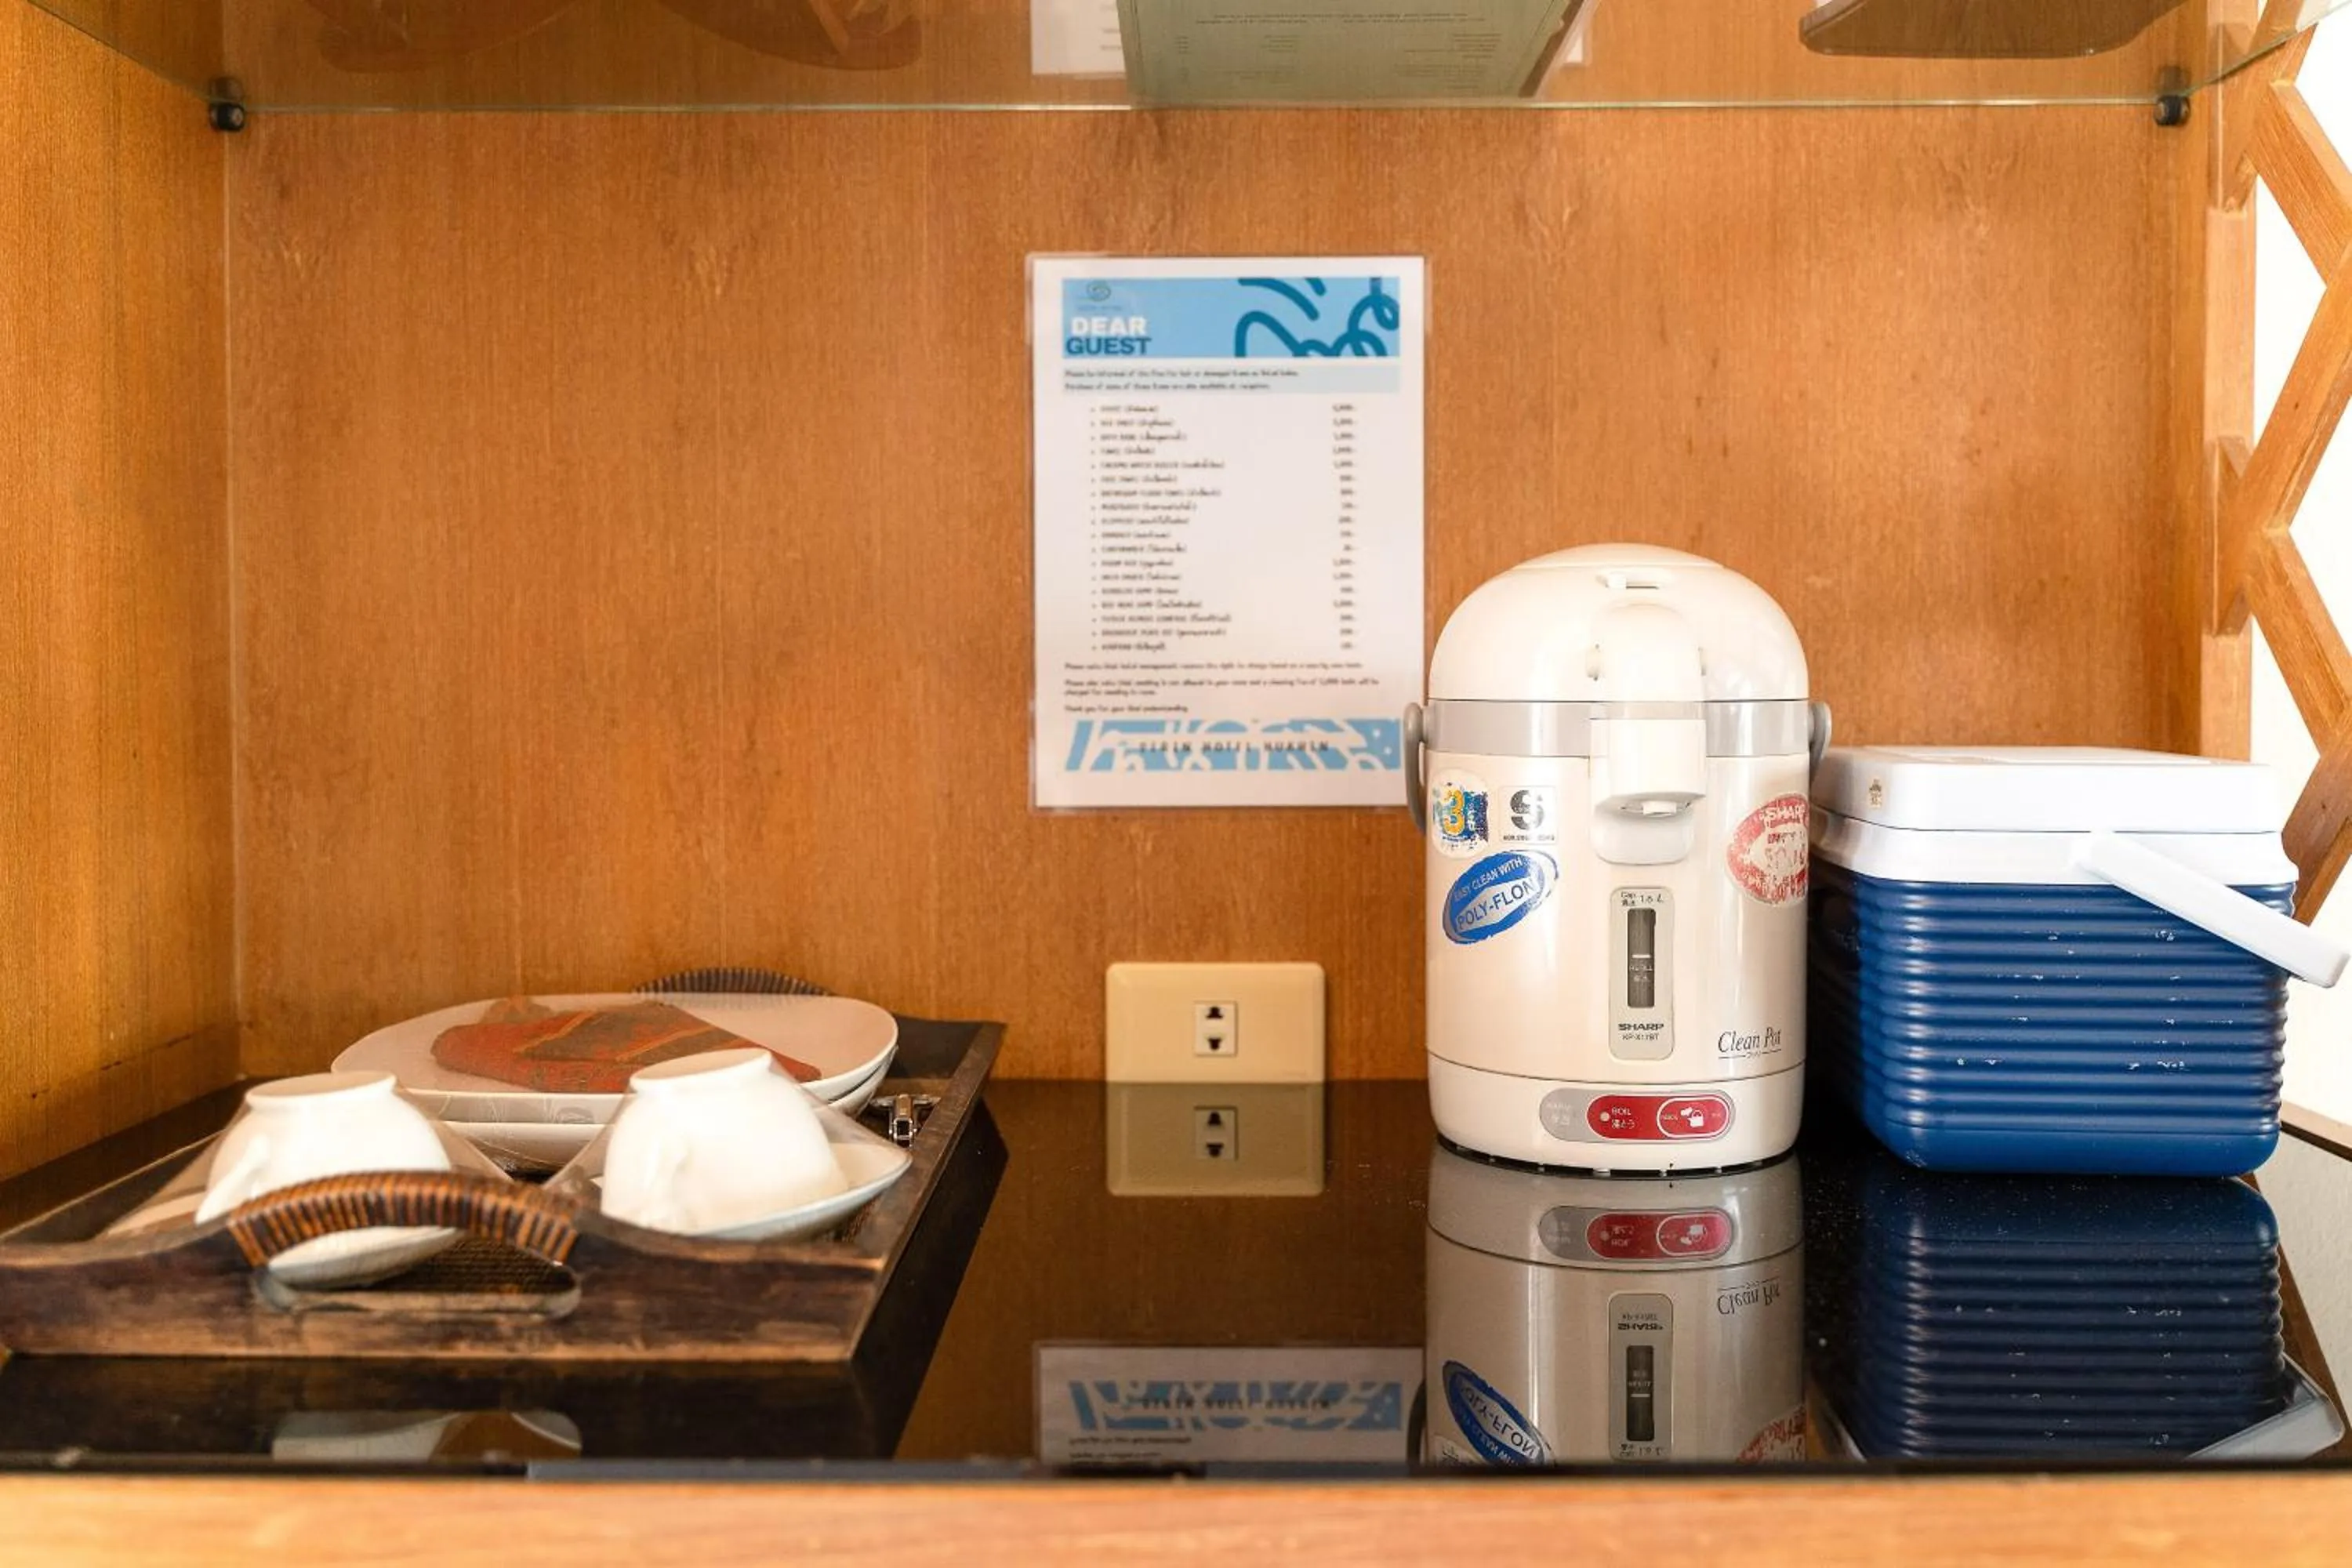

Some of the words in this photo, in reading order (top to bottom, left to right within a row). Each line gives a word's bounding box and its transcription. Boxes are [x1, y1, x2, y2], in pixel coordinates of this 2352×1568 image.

[1071, 316, 1147, 336] DEAR
[1066, 336, 1152, 354] GUEST
[1472, 869, 1498, 890] CLEAN
[1499, 855, 1523, 876] WITH
[1457, 879, 1537, 930] POLY-FLON
[1718, 1030, 1760, 1053] Clean
[1764, 1026, 1782, 1048] Pot
